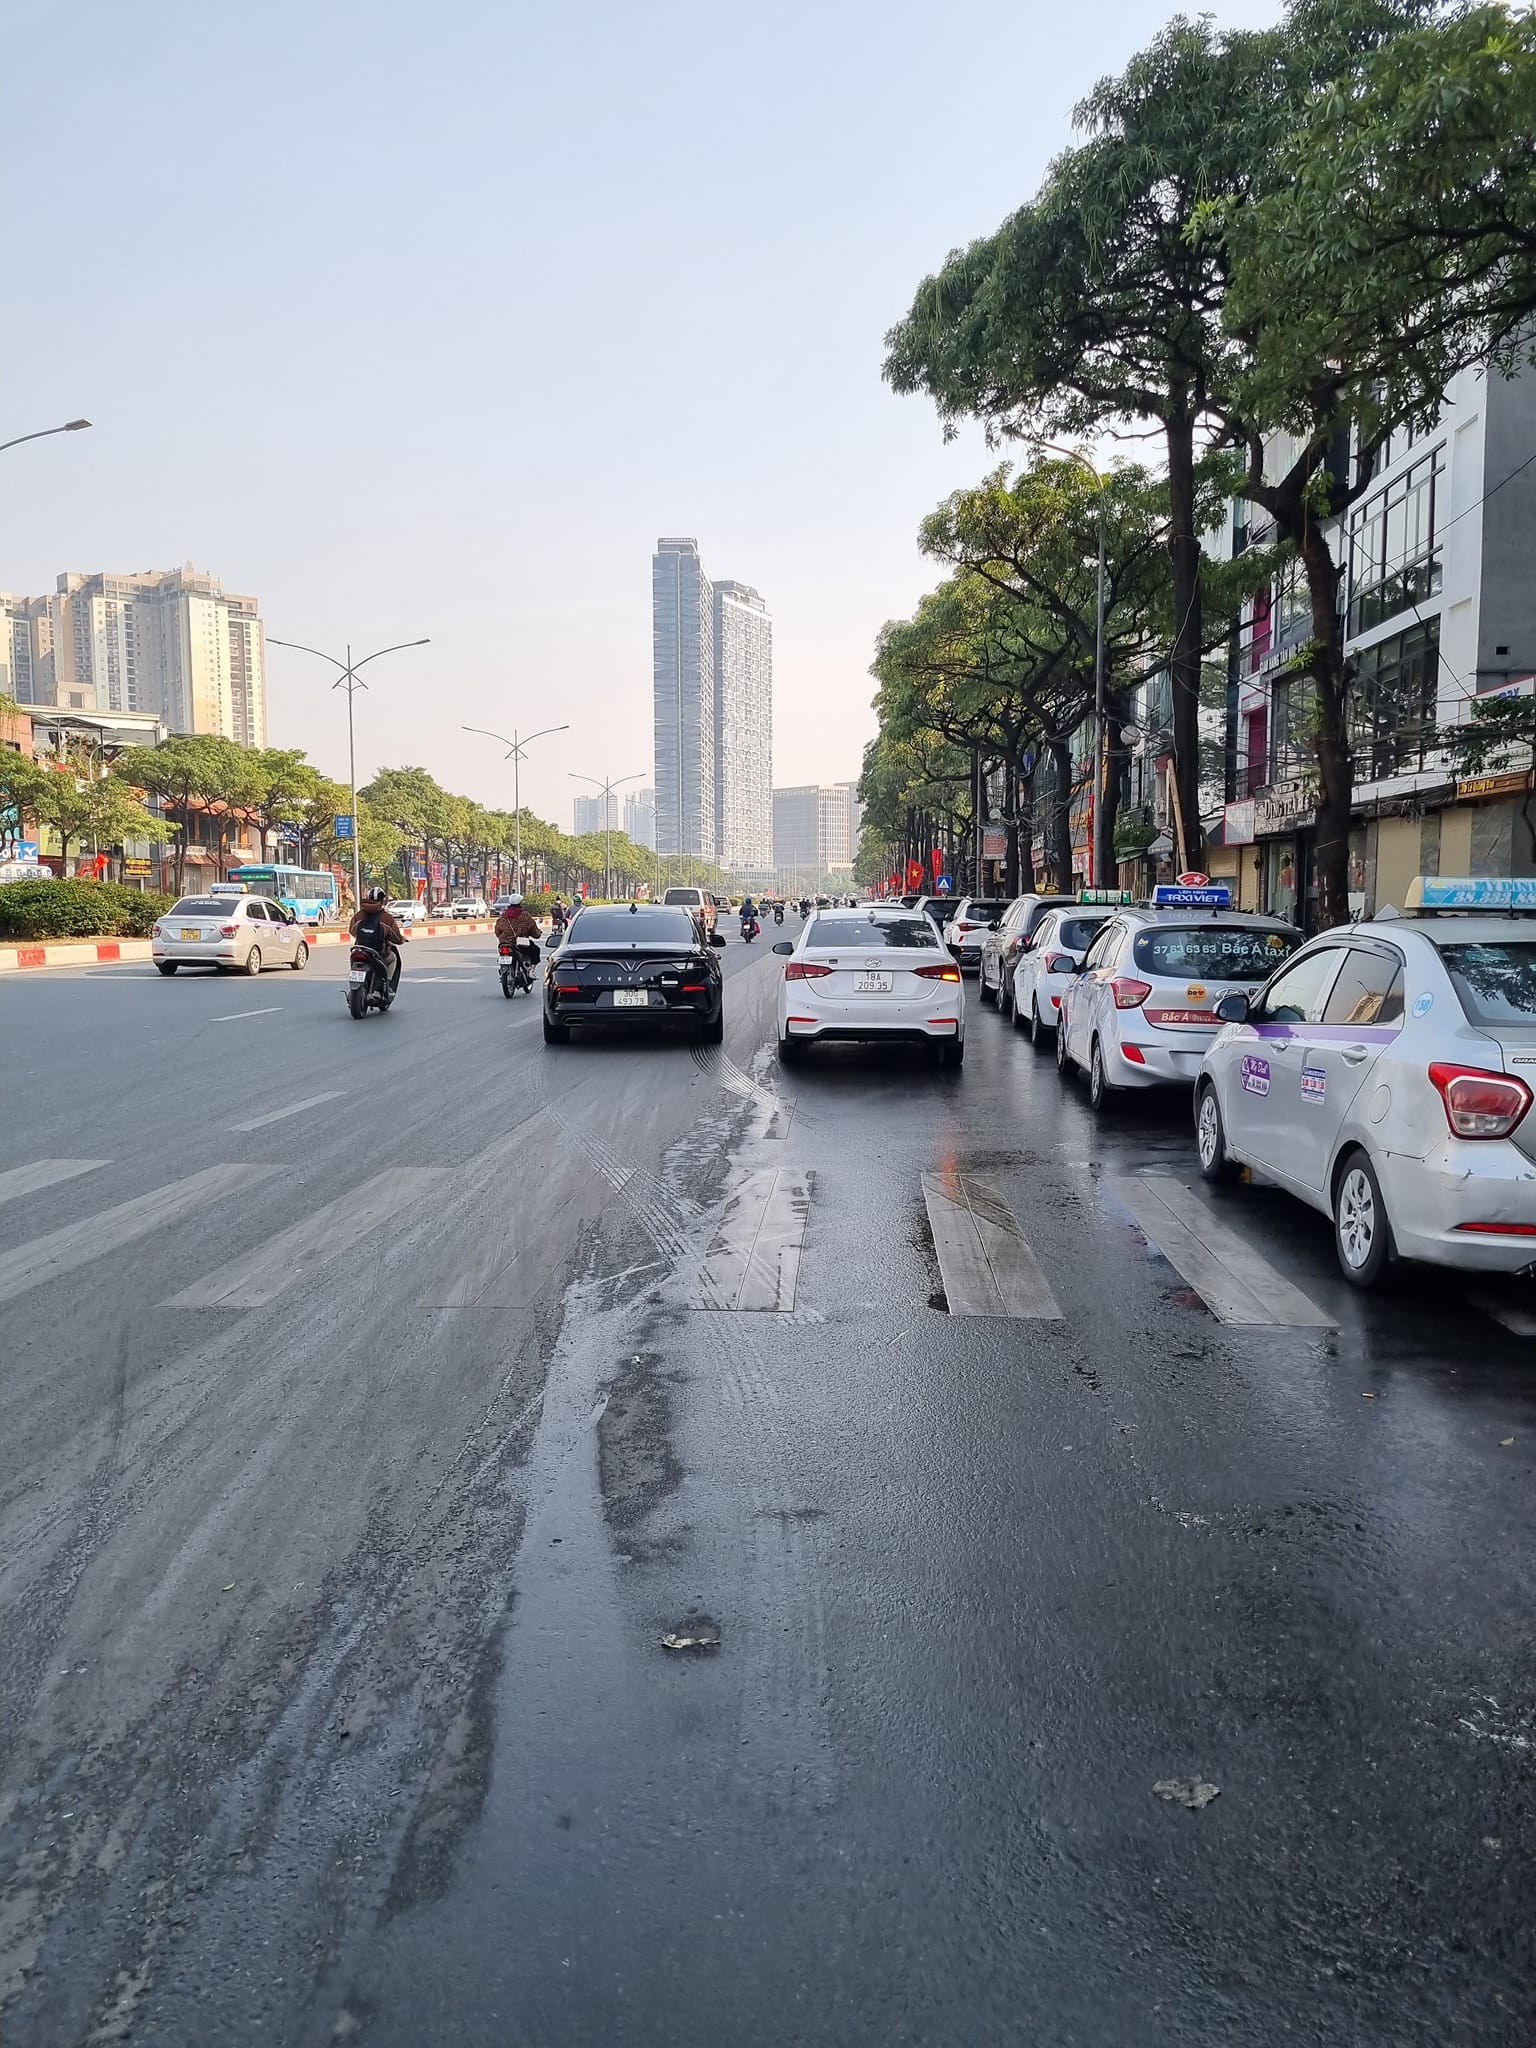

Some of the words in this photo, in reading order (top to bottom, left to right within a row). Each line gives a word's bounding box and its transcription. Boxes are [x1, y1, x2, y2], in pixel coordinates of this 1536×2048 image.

[1153, 945, 1168, 955] 37
[1170, 944, 1184, 954] 63
[1186, 944, 1201, 954] 63
[1202, 944, 1217, 954] 63
[1221, 939, 1249, 955] Bắc
[1251, 941, 1263, 956] Á
[1263, 944, 1292, 958] taxi
[865, 972, 881, 981] 18A
[623, 989, 639, 998] 30G
